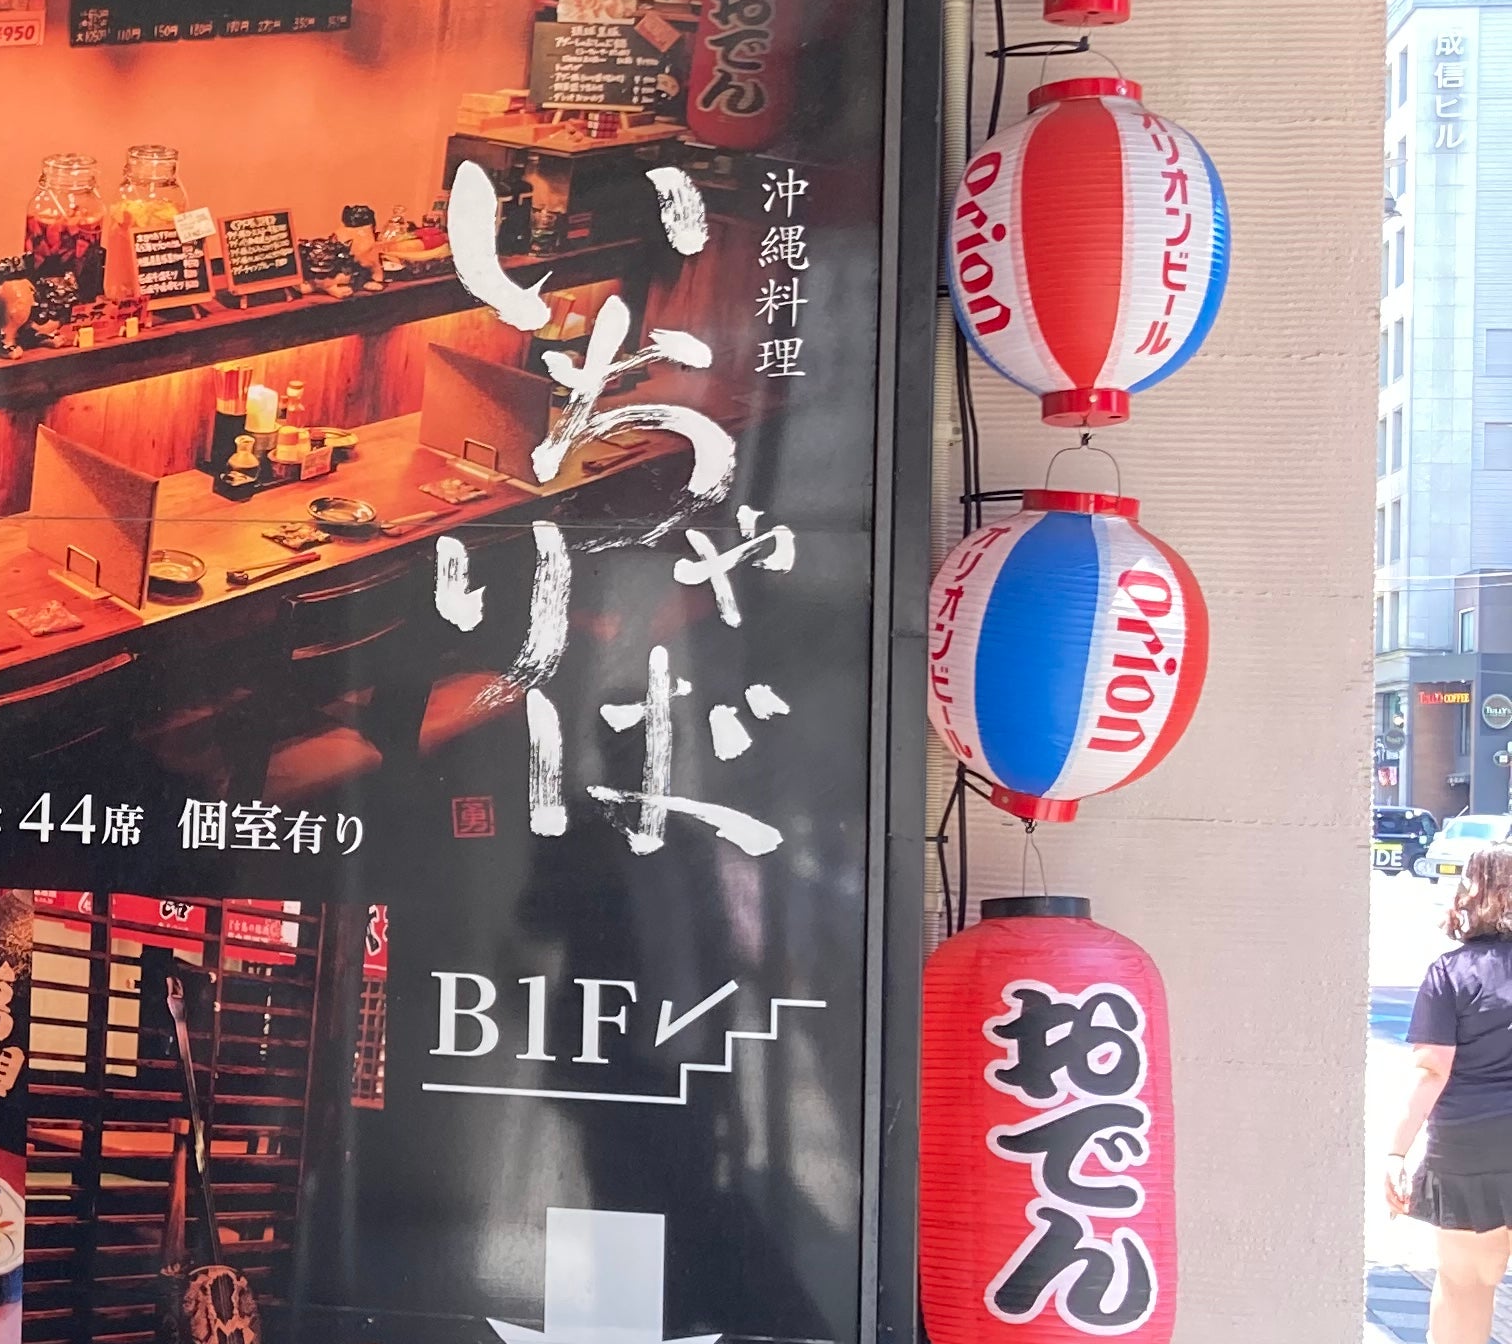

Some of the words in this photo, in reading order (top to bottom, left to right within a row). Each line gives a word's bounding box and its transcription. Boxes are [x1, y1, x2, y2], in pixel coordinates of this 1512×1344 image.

[1434, 31, 1464, 149] 成信ビル
[755, 168, 810, 378] 沖縄料理
[956, 152, 1011, 337] Orion
[1134, 112, 1192, 356] オリオンビール
[931, 526, 1011, 760] オリオンビール
[1087, 569, 1177, 753] Orion
[1444, 692, 1470, 704] COFFEE
[177, 799, 364, 855] 個室有り
[429, 971, 637, 1064] B1F
[987, 983, 1155, 1331] おでん
